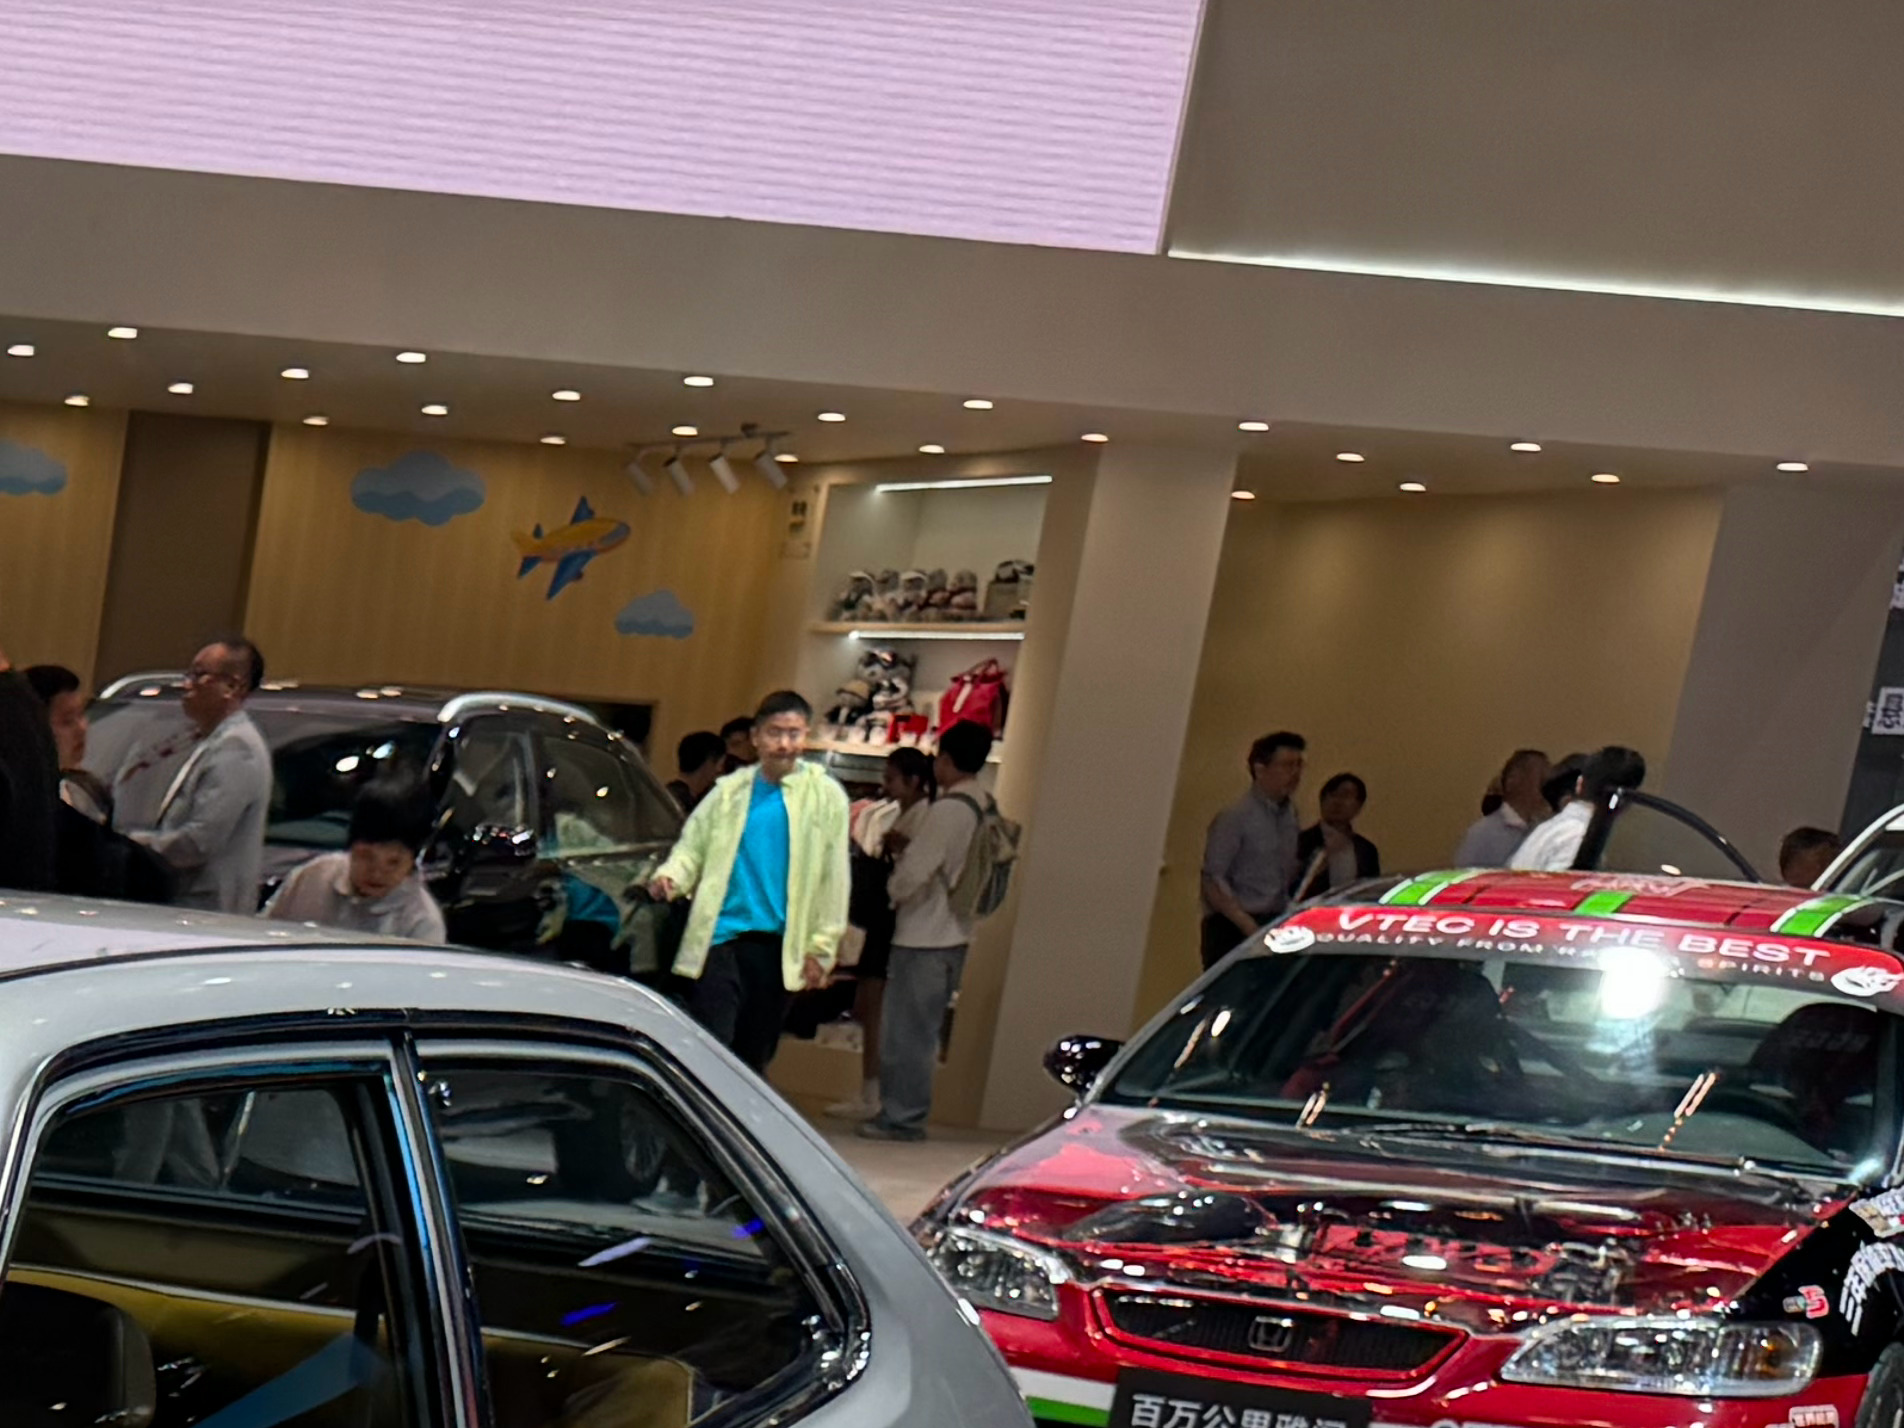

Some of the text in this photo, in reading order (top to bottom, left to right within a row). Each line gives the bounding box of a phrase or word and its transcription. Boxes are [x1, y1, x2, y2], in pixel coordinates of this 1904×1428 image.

[1316, 932, 1444, 946] QUALITY
[1456, 938, 1544, 954] FROM
[1339, 912, 1475, 934] VTEC
[1489, 919, 1540, 938] IS
[1559, 924, 1665, 947] THE
[1678, 934, 1831, 966] BEST
